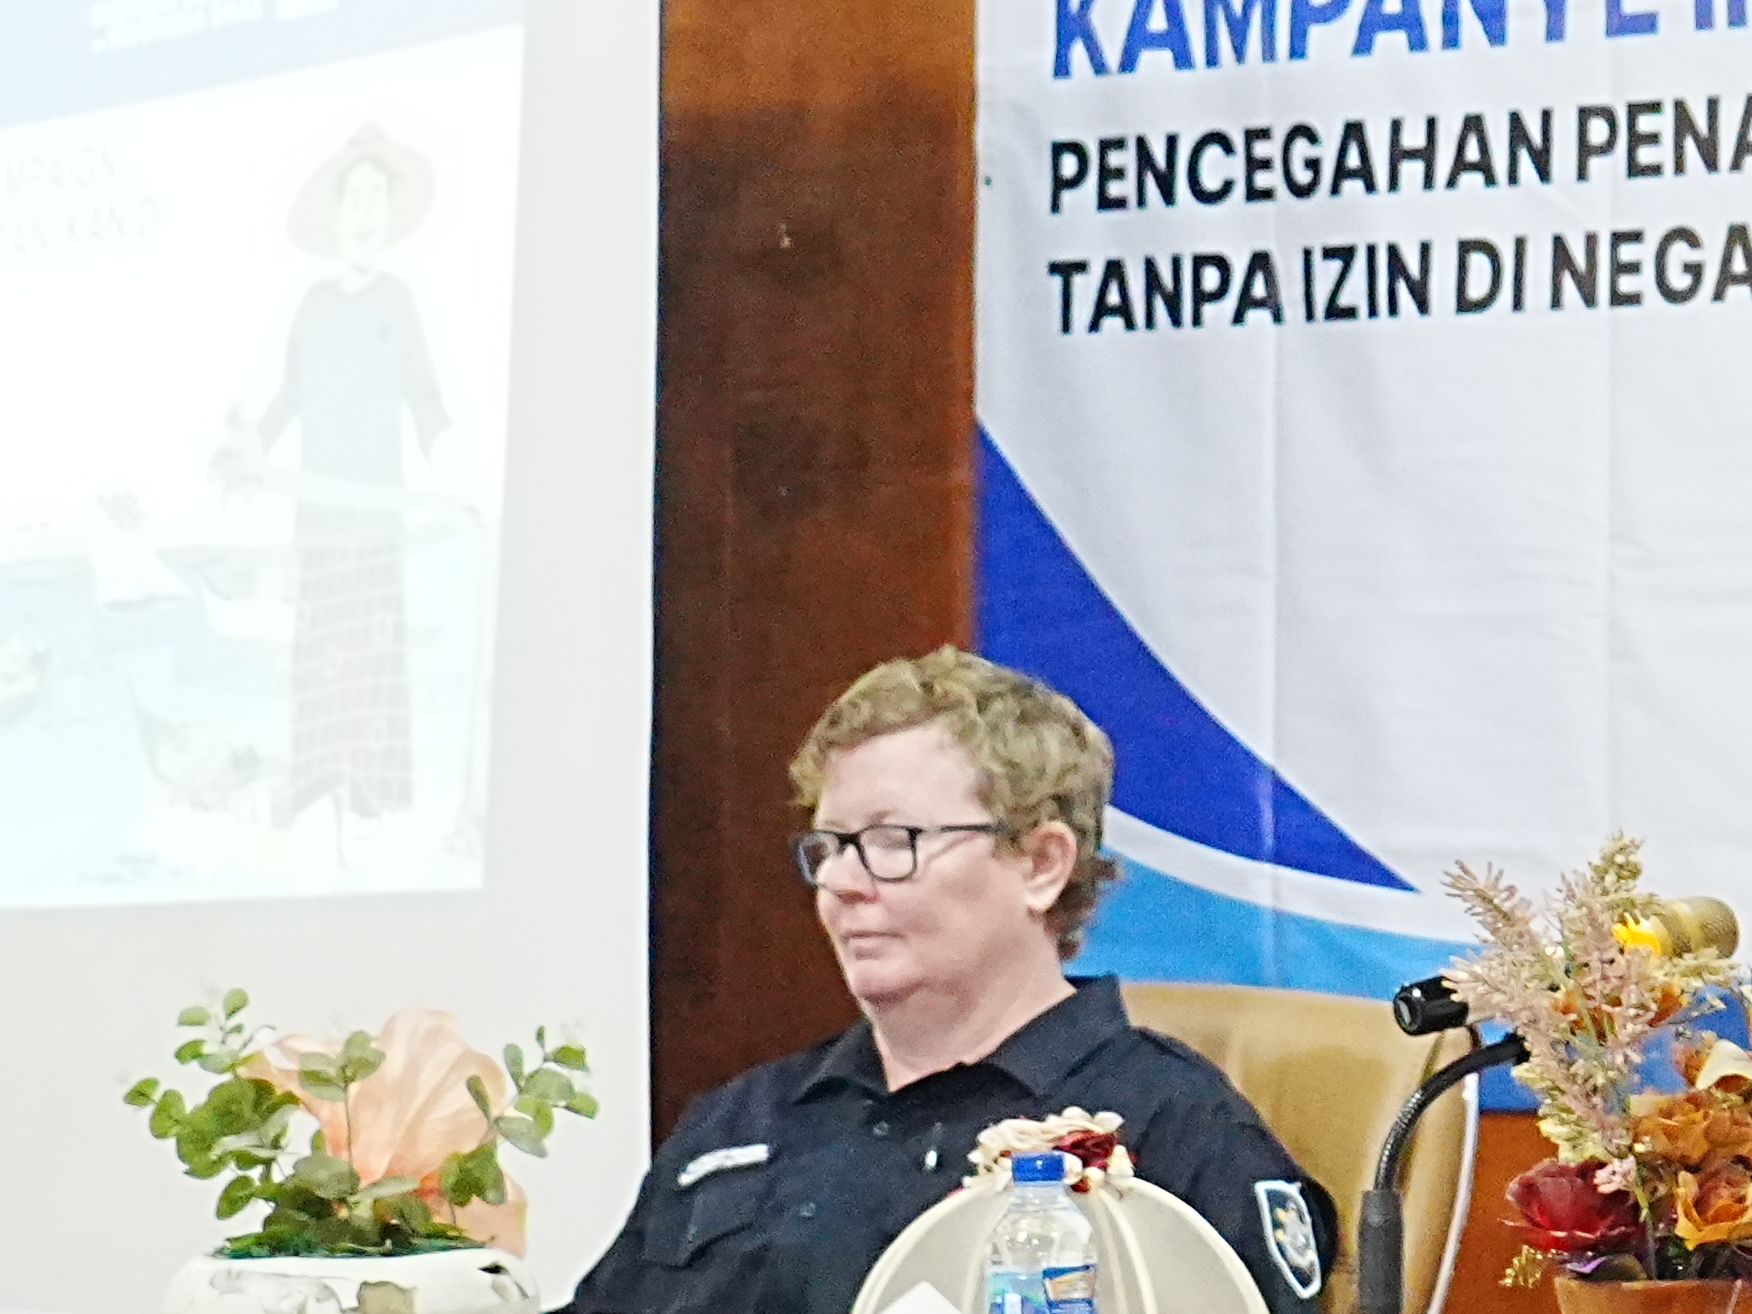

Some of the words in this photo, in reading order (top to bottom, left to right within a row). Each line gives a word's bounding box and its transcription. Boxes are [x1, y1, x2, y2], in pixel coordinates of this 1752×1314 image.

[1050, 109, 1552, 215] PENCEGAHAN
[1047, 250, 1284, 335] TANPA
[1302, 240, 1431, 323] IZIN
[1456, 237, 1526, 315] DI
